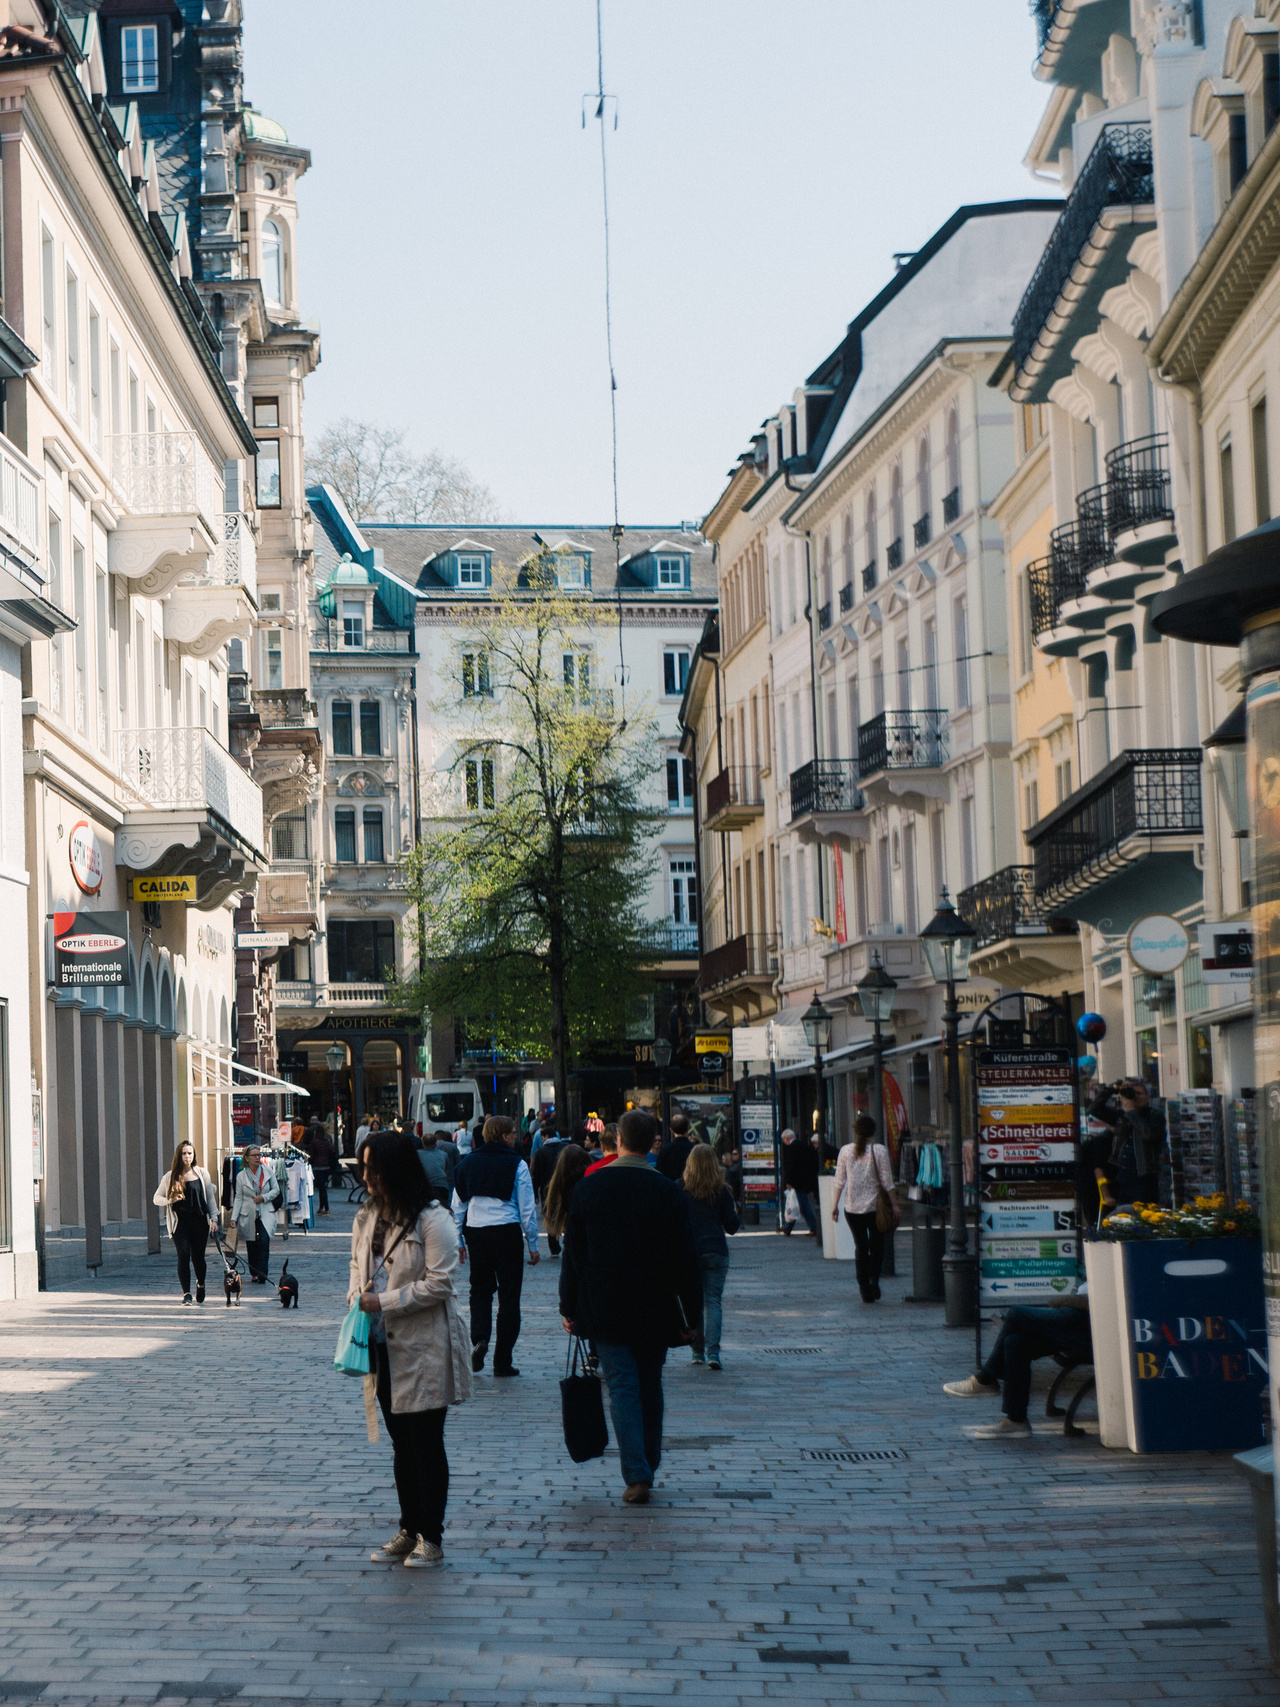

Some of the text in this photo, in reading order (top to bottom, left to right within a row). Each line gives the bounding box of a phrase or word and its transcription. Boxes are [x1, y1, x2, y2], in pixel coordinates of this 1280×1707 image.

[139, 881, 190, 893] CALIDA
[61, 939, 119, 948] OPTIK EBERLE
[61, 962, 122, 973] Internationale
[61, 972, 122, 983] Brillenmode
[957, 992, 991, 1006] ONITA
[326, 1017, 396, 1028] APOTHEKE
[993, 1052, 1058, 1062] Küferstraße
[980, 1069, 1070, 1079] STEUERKANZLEI
[989, 1124, 1072, 1138] Schneiderei
[1018, 1260, 1066, 1268] Fußpflege
[1137, 1347, 1268, 1382] BADEN
